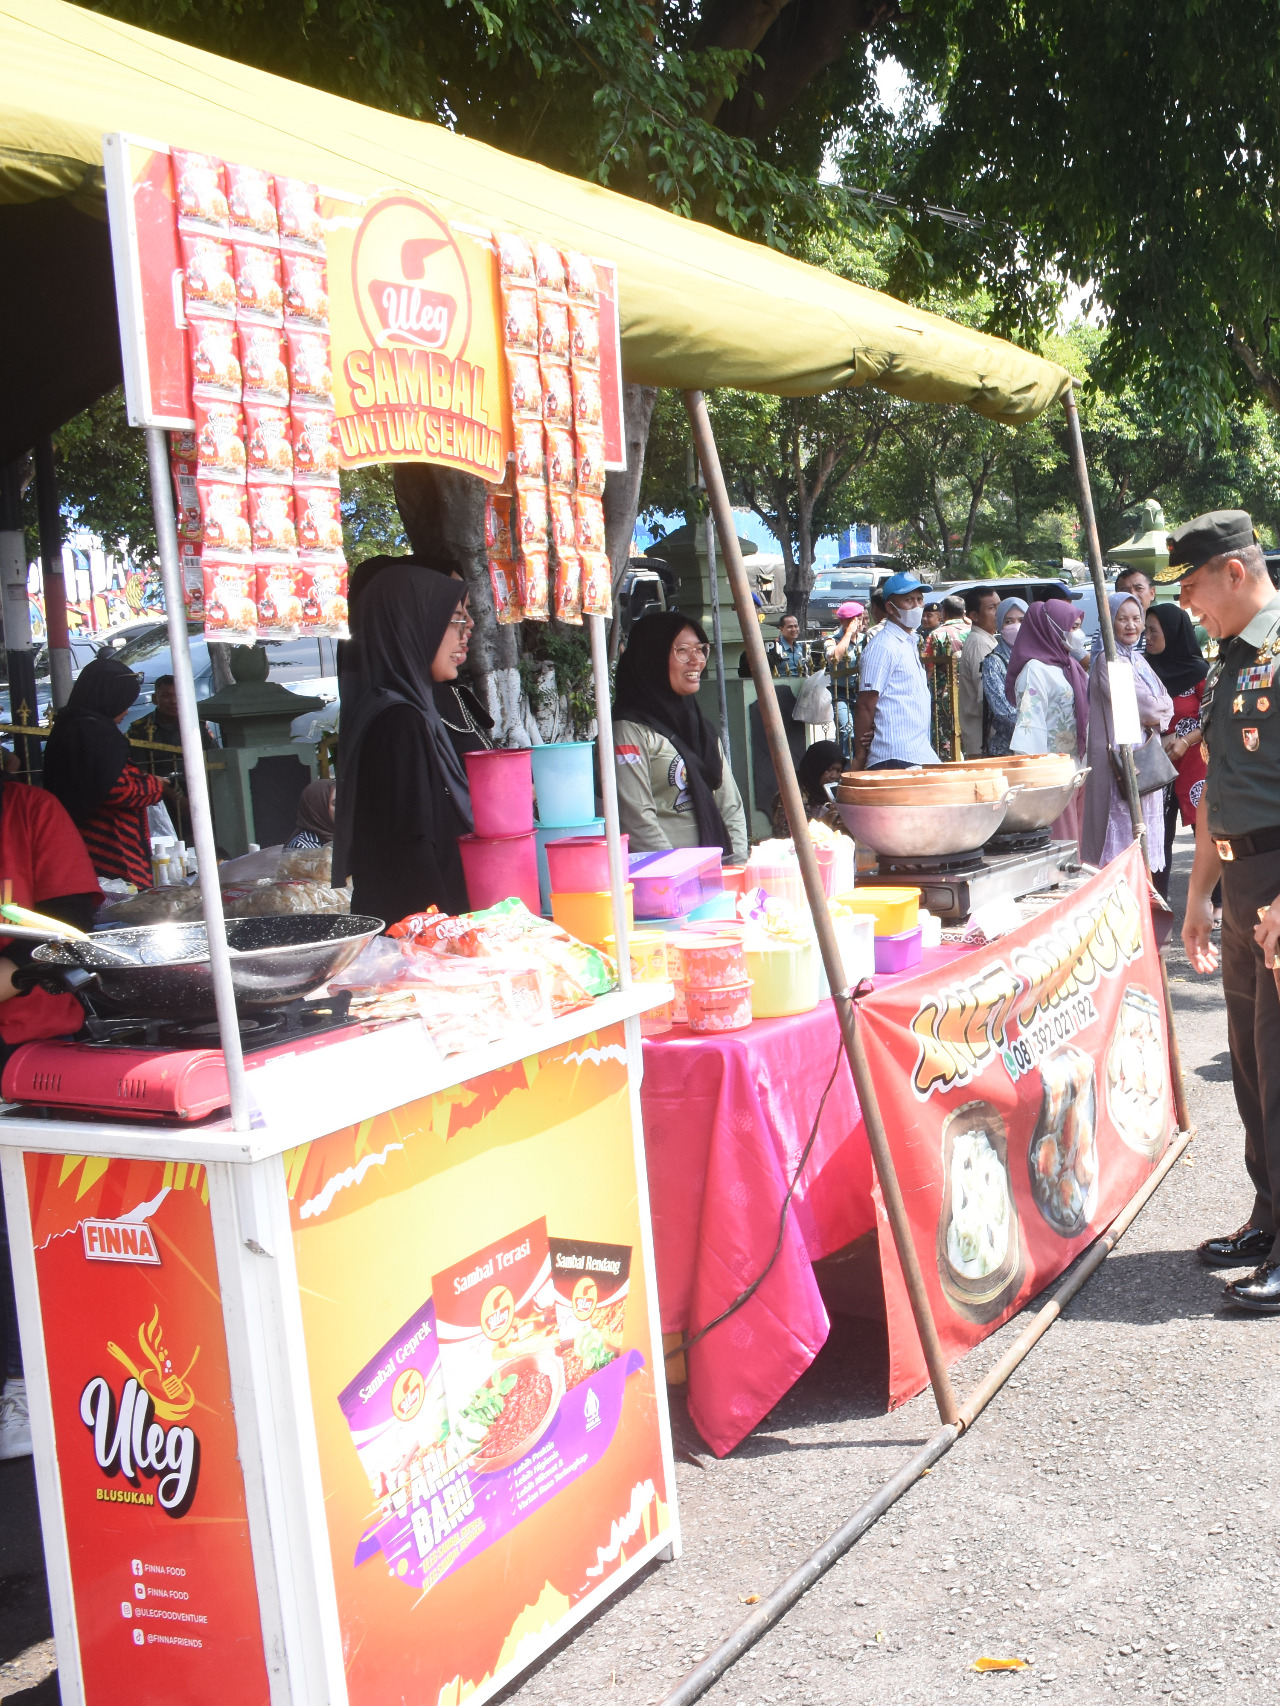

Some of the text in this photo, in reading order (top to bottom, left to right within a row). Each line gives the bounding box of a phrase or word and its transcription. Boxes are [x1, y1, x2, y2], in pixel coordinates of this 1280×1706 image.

[376, 286, 448, 347] Uleg
[346, 348, 488, 426] SAMBAL
[336, 411, 423, 457] UNTUK
[425, 413, 502, 472] SEMUA
[913, 966, 1021, 1094] ANET
[1013, 995, 1096, 1069] 081 392 021 192
[86, 1225, 154, 1257] FINNA
[453, 1238, 532, 1295] Sambal Terasi
[555, 1252, 622, 1276] Sambal Rendang
[358, 1319, 433, 1405] Sambal Geprek
[80, 1376, 195, 1509] Uleg
[513, 1458, 532, 1476] Lebih
[515, 1470, 533, 1488] Lebih
[95, 1488, 154, 1506] BLUSUKAN
[516, 1481, 535, 1500] Lebih
[410, 1473, 475, 1559] BARU
[144, 1563, 187, 1577] FINNA FOOD
[147, 1587, 190, 1600] FINNA FOOD
[134, 1607, 208, 1624] @ULEGFOODVENTURE
[146, 1633, 203, 1648] @FINNAFRIENDS
